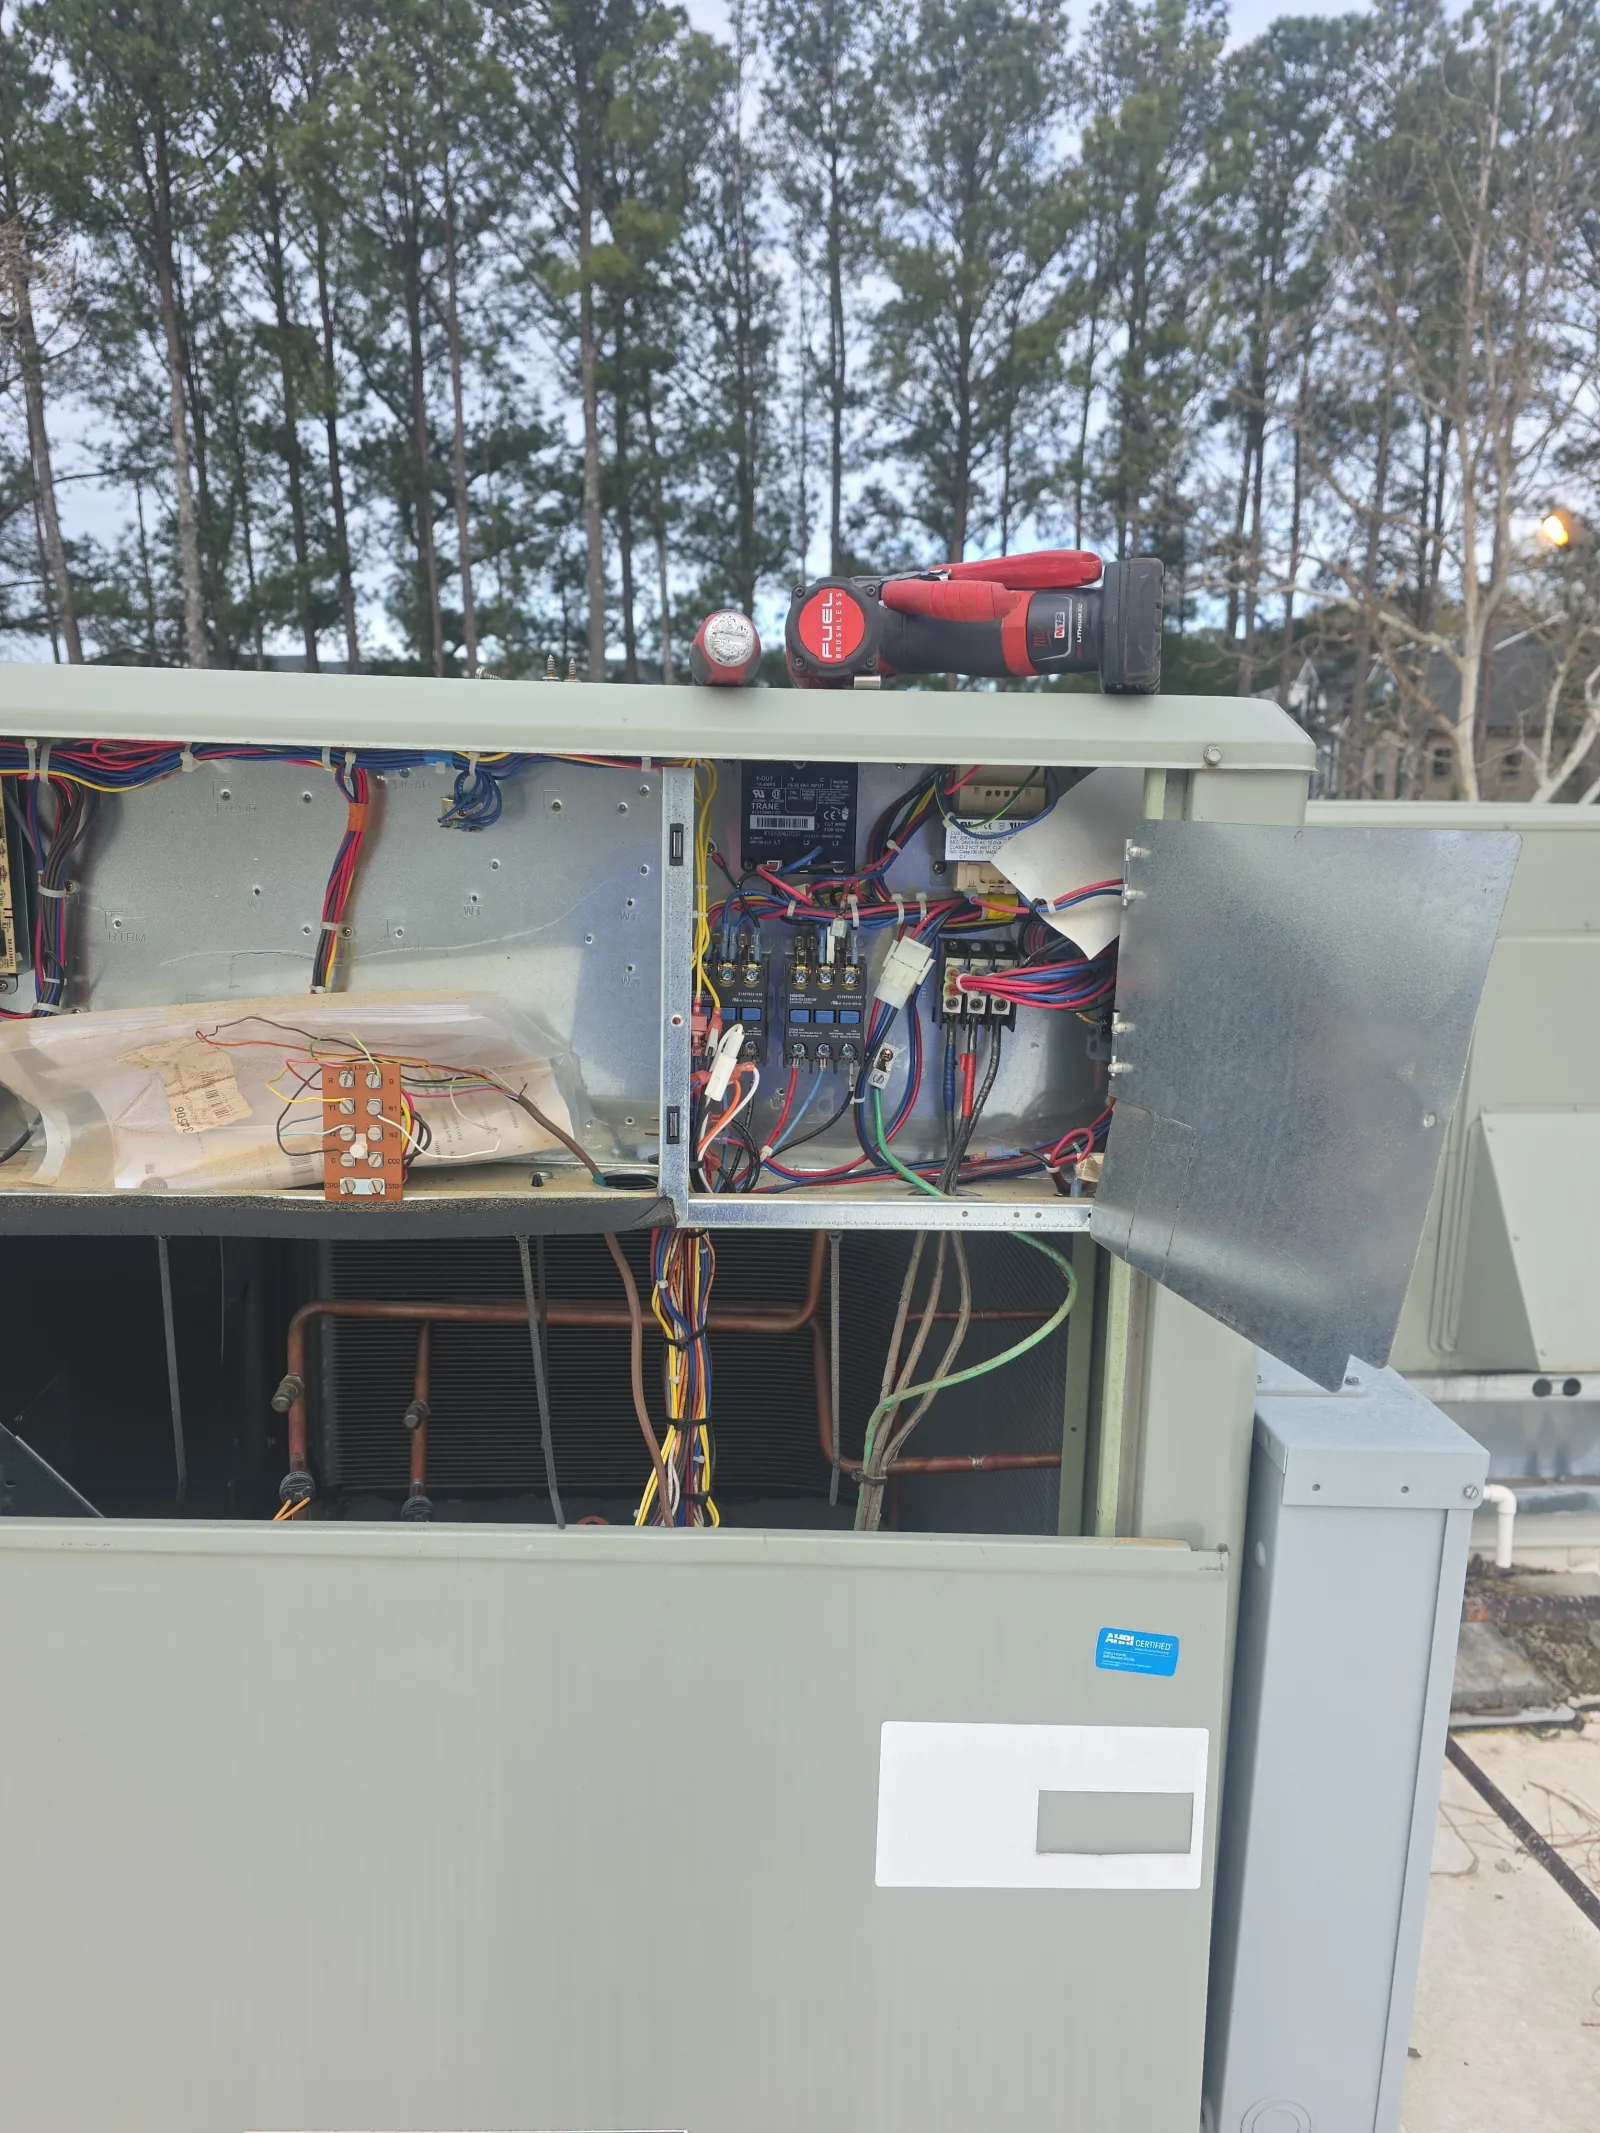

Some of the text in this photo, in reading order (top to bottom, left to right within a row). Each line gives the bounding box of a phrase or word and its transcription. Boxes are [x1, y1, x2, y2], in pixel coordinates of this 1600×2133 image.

[822, 593, 833, 658] FUEL
[1055, 613, 1064, 637] M12
[1105, 1632, 1171, 1651] AHRI CERTIFIED
